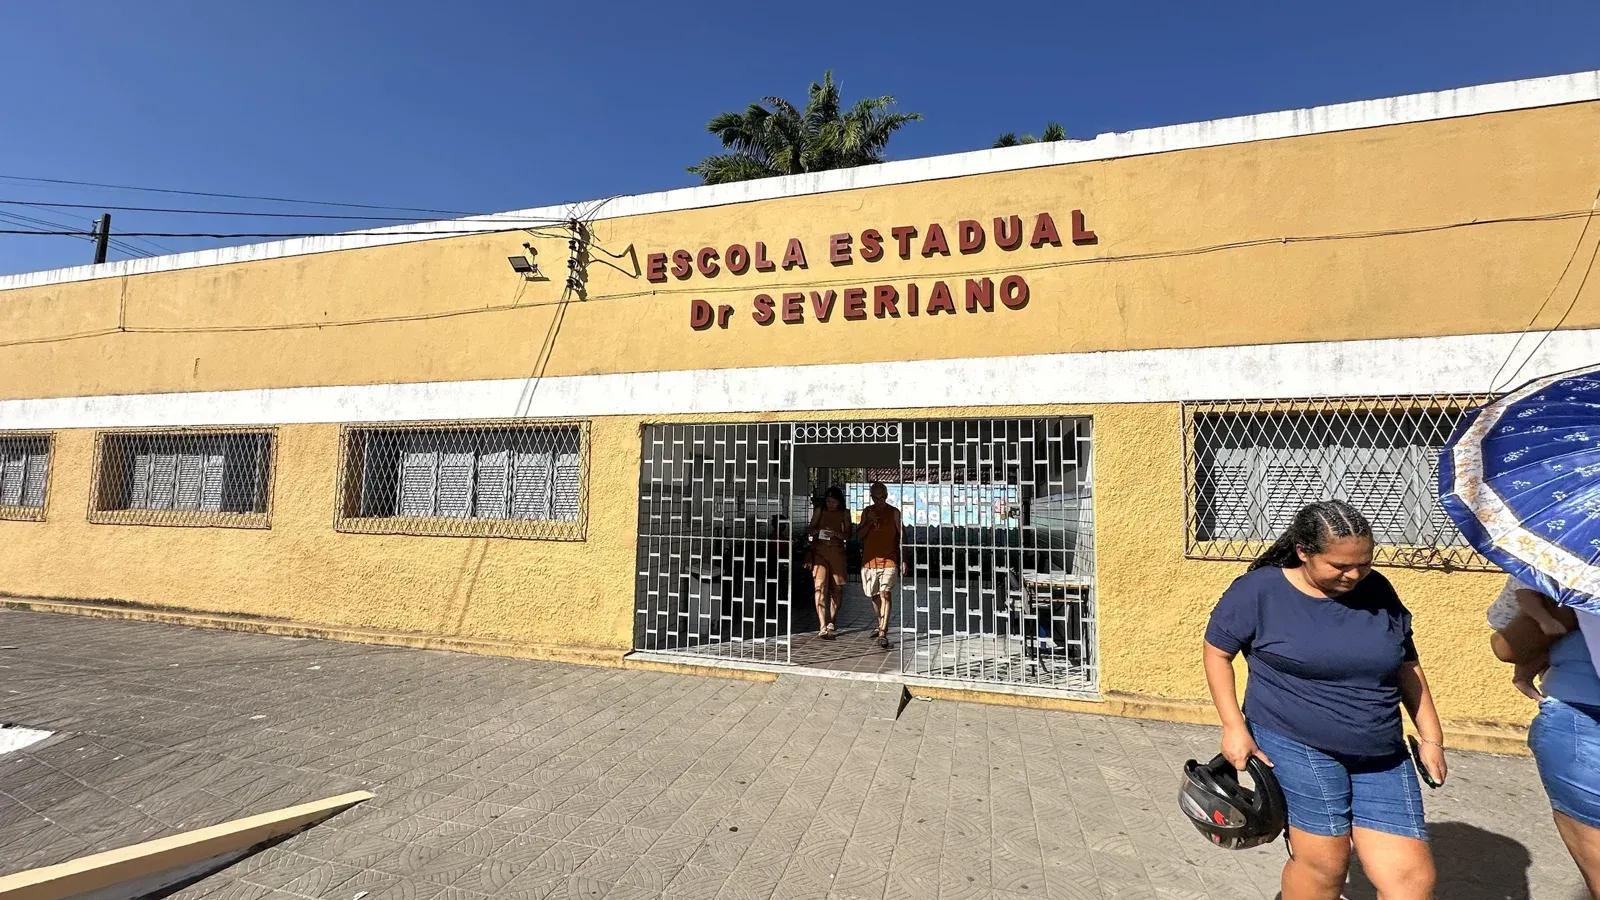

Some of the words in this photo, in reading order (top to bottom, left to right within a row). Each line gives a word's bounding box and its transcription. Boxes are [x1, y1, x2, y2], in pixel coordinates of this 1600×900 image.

[646, 238, 808, 283] ESCOLA
[829, 209, 1098, 266] ESTADUAL
[690, 299, 734, 330] Dr
[752, 274, 1030, 327] SEVERIANO
